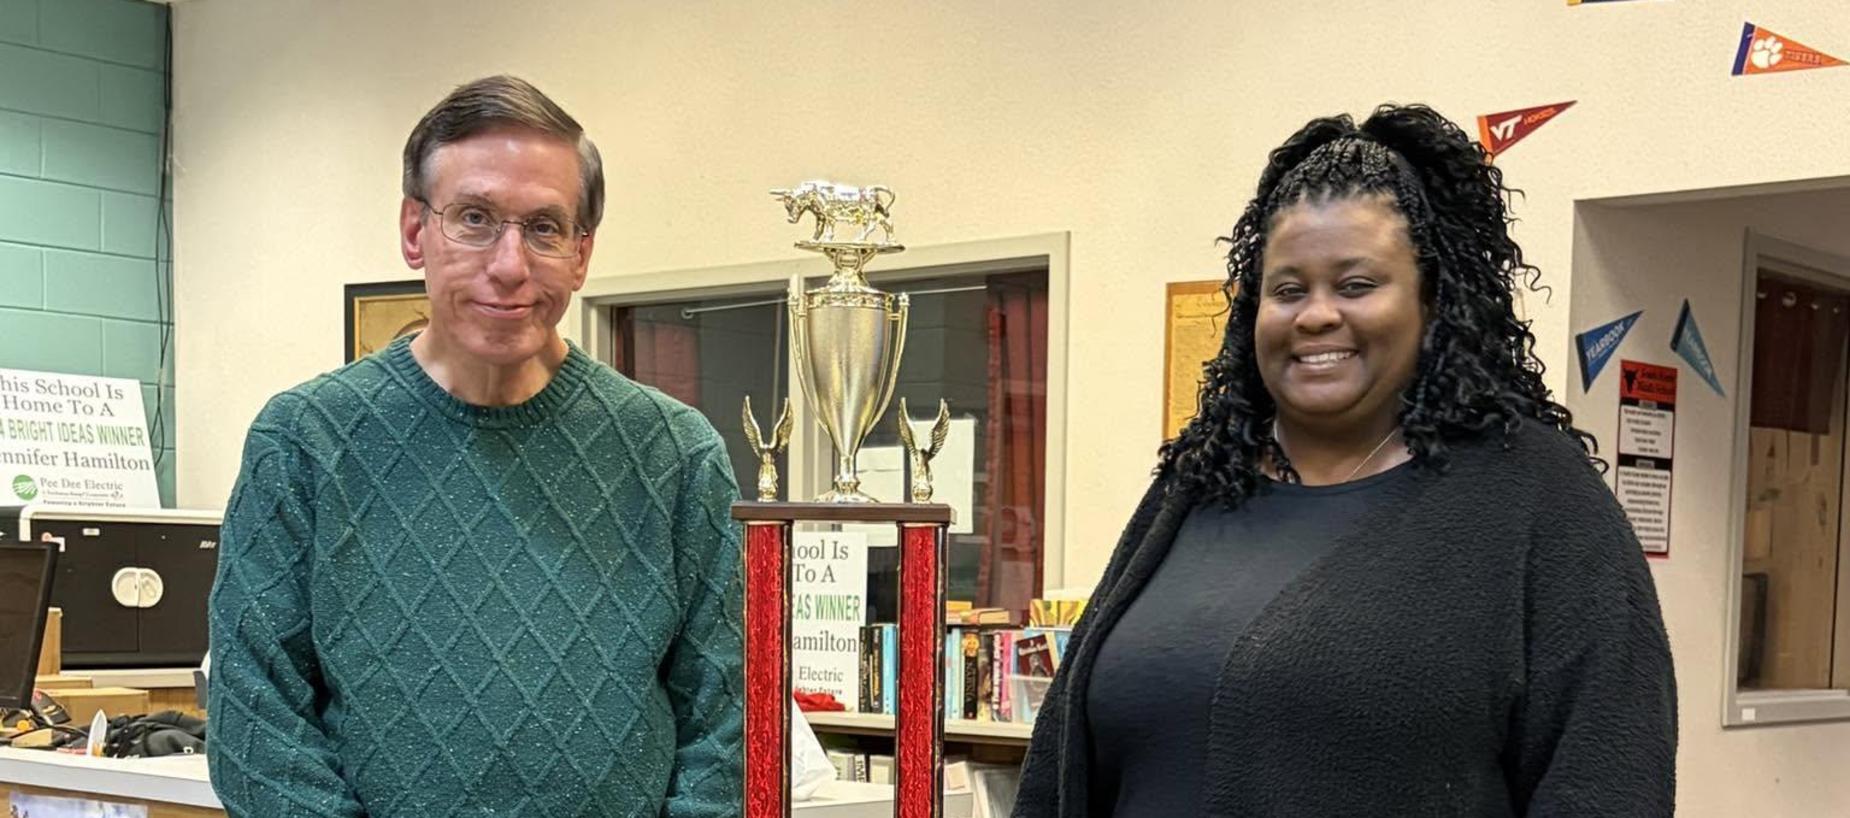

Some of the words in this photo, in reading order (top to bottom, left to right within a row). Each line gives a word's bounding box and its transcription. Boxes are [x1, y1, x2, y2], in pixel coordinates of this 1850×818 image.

[1489, 114, 1523, 140] VT
[0, 375, 30, 393] his
[35, 378, 100, 398] School
[106, 384, 124, 400] Is
[3, 395, 63, 413] Home
[68, 399, 94, 416] To
[100, 402, 115, 417] A
[8, 418, 53, 442] BRIGHT
[57, 422, 95, 444] IDEAS
[96, 424, 145, 447] WINNER
[0, 448, 59, 467] nnifer
[63, 451, 150, 471] Hamilton
[40, 477, 58, 488] Pee
[61, 478, 81, 488] Dee
[85, 479, 123, 491] Electric
[792, 539, 825, 560] ool
[832, 540, 849, 560] Is
[793, 563, 816, 583] To
[821, 565, 837, 583] A
[815, 594, 861, 621] WINNER
[793, 630, 857, 653] amilton
[799, 666, 844, 682] Electric
